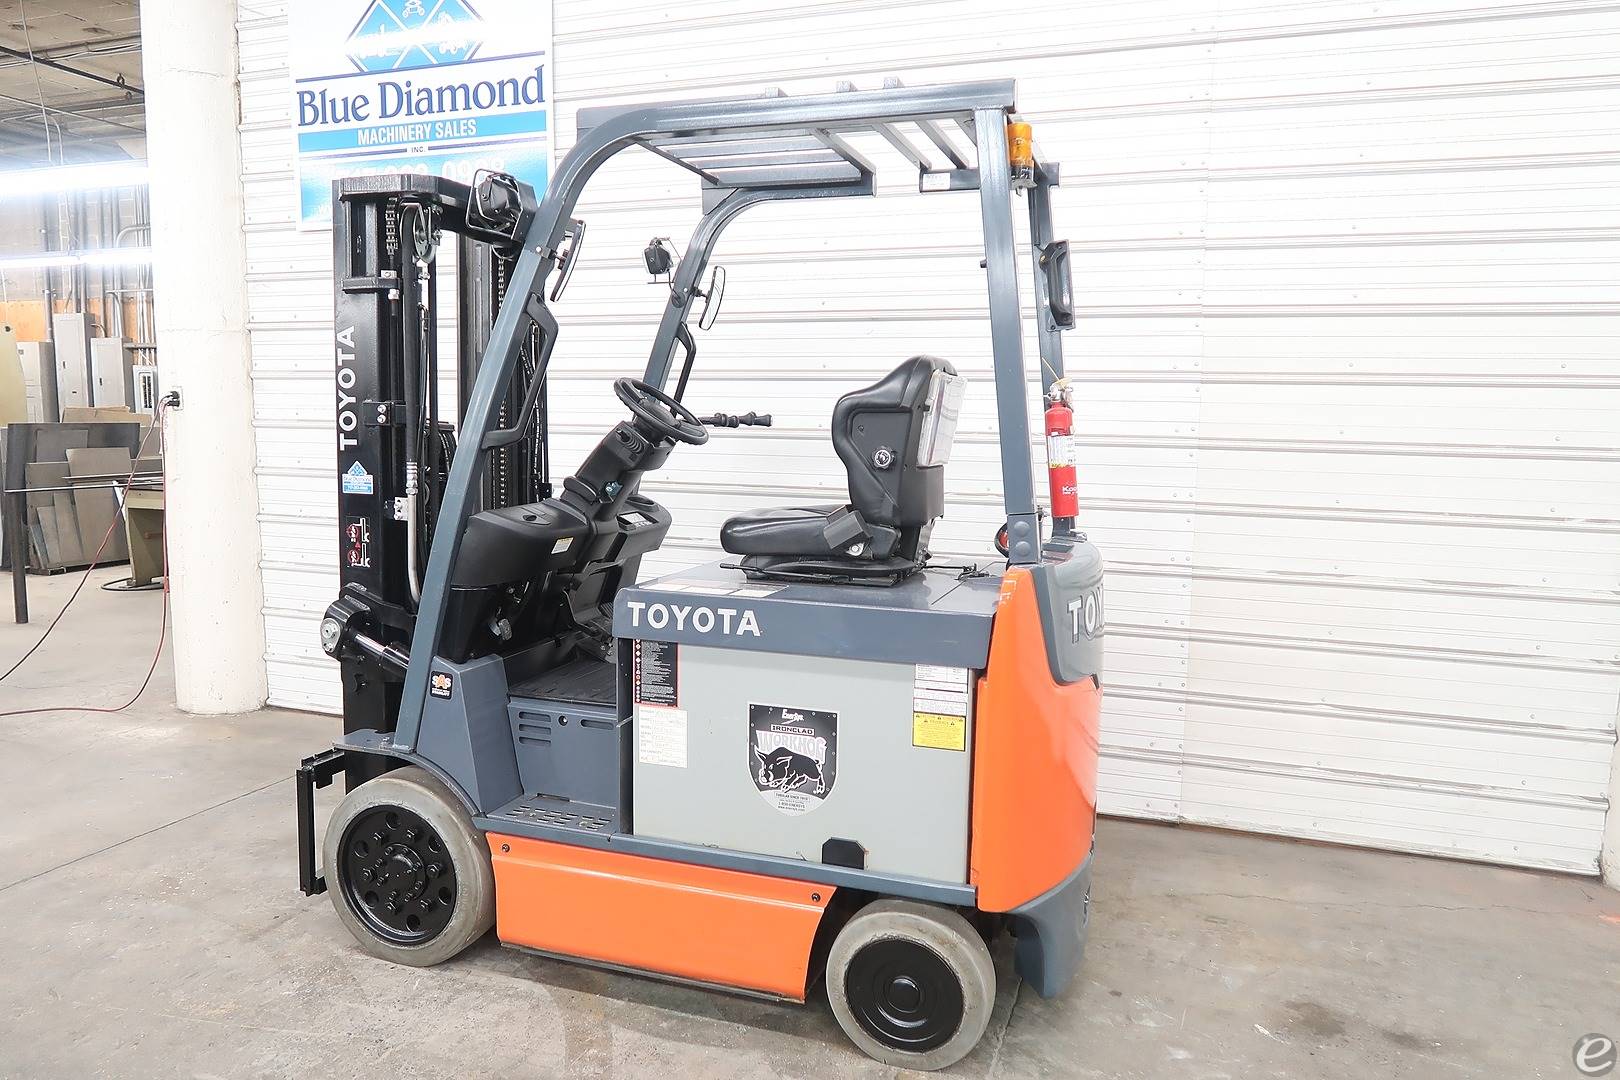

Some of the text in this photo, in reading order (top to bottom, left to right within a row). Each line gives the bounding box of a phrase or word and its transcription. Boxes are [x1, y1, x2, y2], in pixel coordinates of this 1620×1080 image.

[297, 64, 546, 126] Blue Diamond
[357, 119, 477, 145] MACHINERY SALES
[336, 325, 359, 451] TOYOTA
[627, 601, 761, 637] TOYOTA
[431, 674, 452, 689] SAS
[772, 725, 814, 735] IRONCLAD
